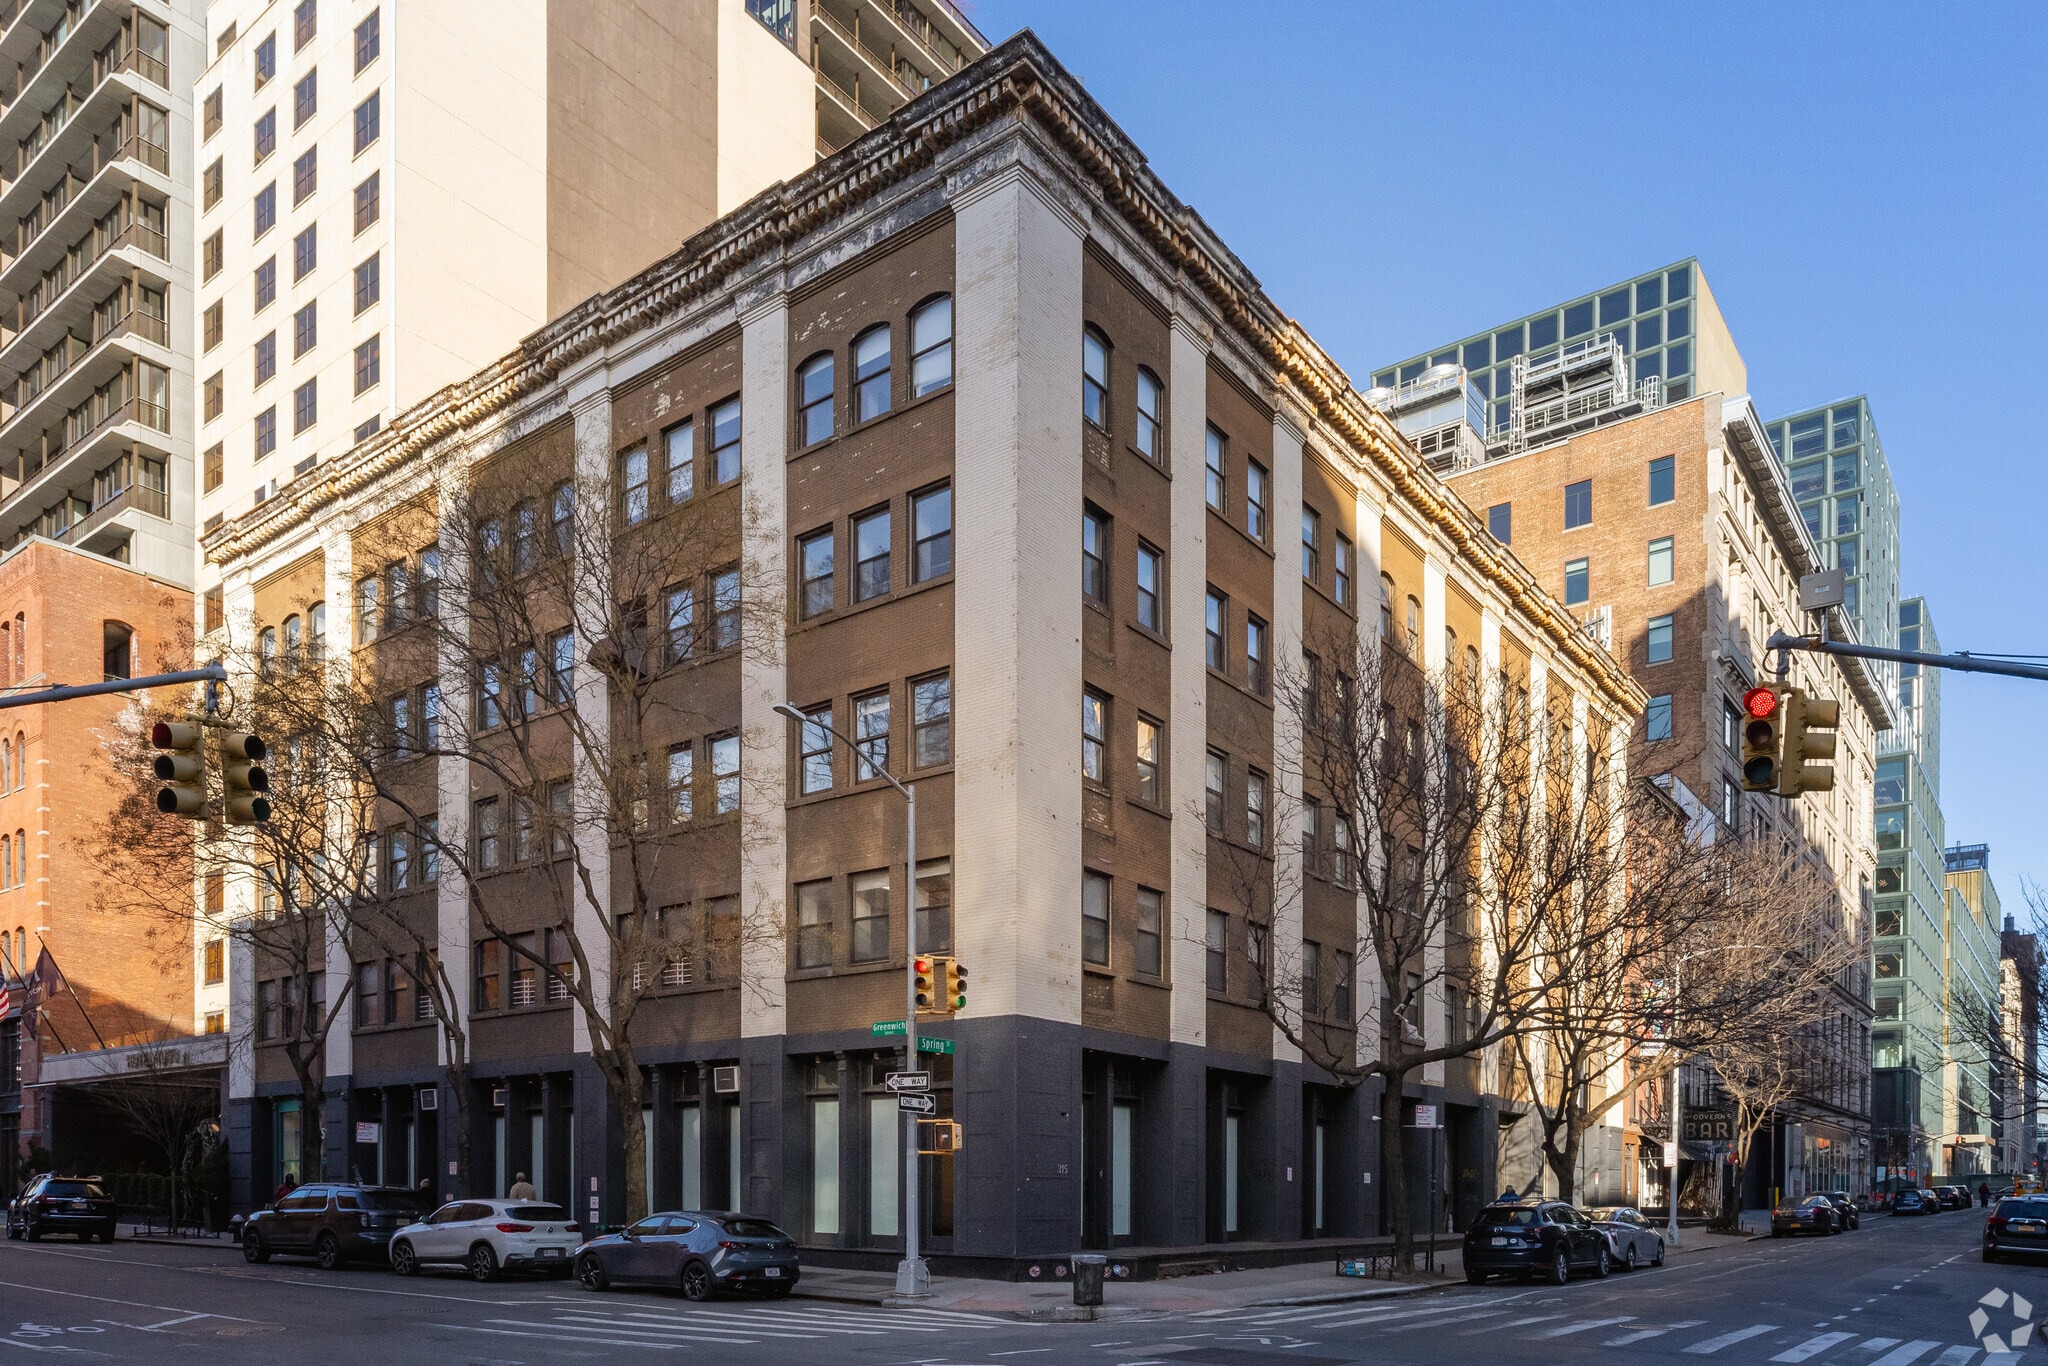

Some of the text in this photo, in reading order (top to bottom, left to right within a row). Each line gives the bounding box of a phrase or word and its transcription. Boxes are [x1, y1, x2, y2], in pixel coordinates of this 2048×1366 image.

[872, 1021, 906, 1032] Greenwich
[921, 1038, 945, 1053] Spring
[911, 1077, 926, 1085] WAY
[902, 1098, 913, 1106] ONE
[1685, 1122, 1729, 1138] BAR
